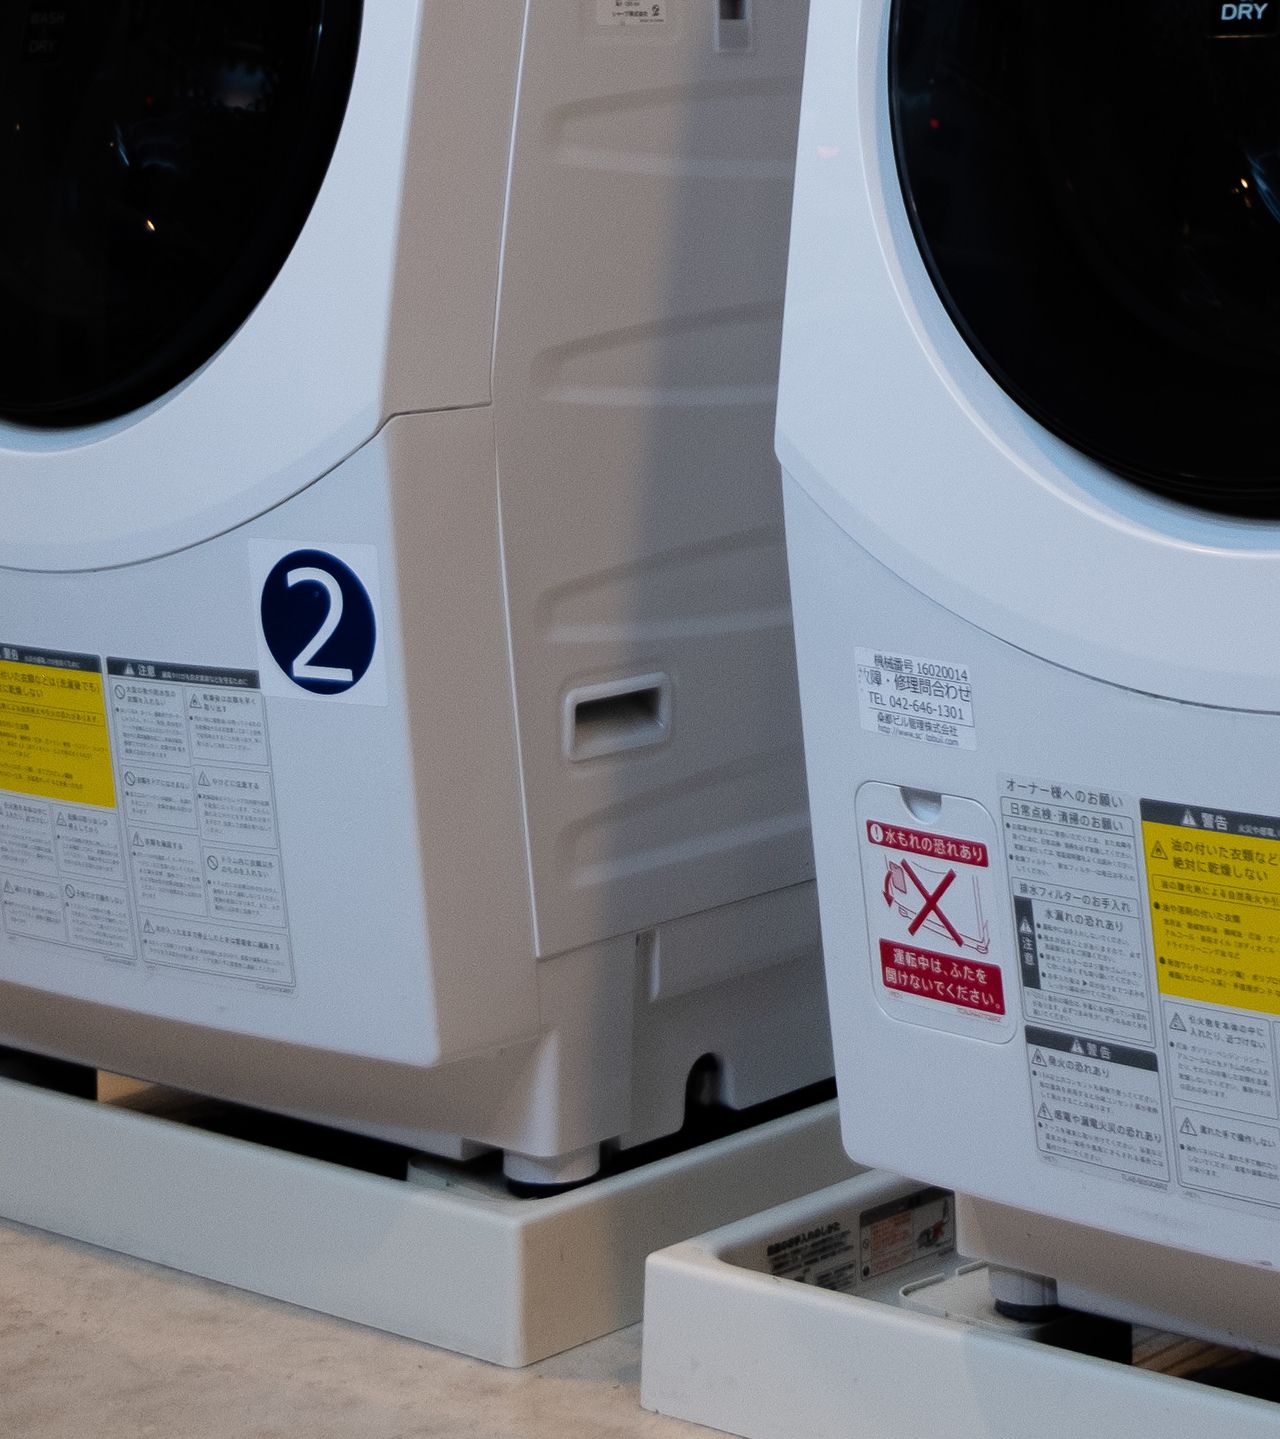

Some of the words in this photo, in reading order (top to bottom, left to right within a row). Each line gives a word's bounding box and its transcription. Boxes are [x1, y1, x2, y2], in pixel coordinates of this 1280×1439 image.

[1220, 3, 1268, 20] DRY
[287, 566, 353, 682] 2
[917, 662, 968, 681] 16020014
[869, 691, 887, 706] TEL
[889, 695, 964, 720] 042-646-1301
[1006, 778, 1123, 808] オーナー様へのお願い
[1201, 812, 1228, 832] 警告
[885, 830, 983, 862] 水もれの恐れあり
[1173, 857, 1269, 881] 絶対に乾燥しない
[892, 948, 987, 985] 運転中は、ふたを
[885, 967, 1002, 1010] 開けないでください。
[1086, 1042, 1111, 1059] 警告
